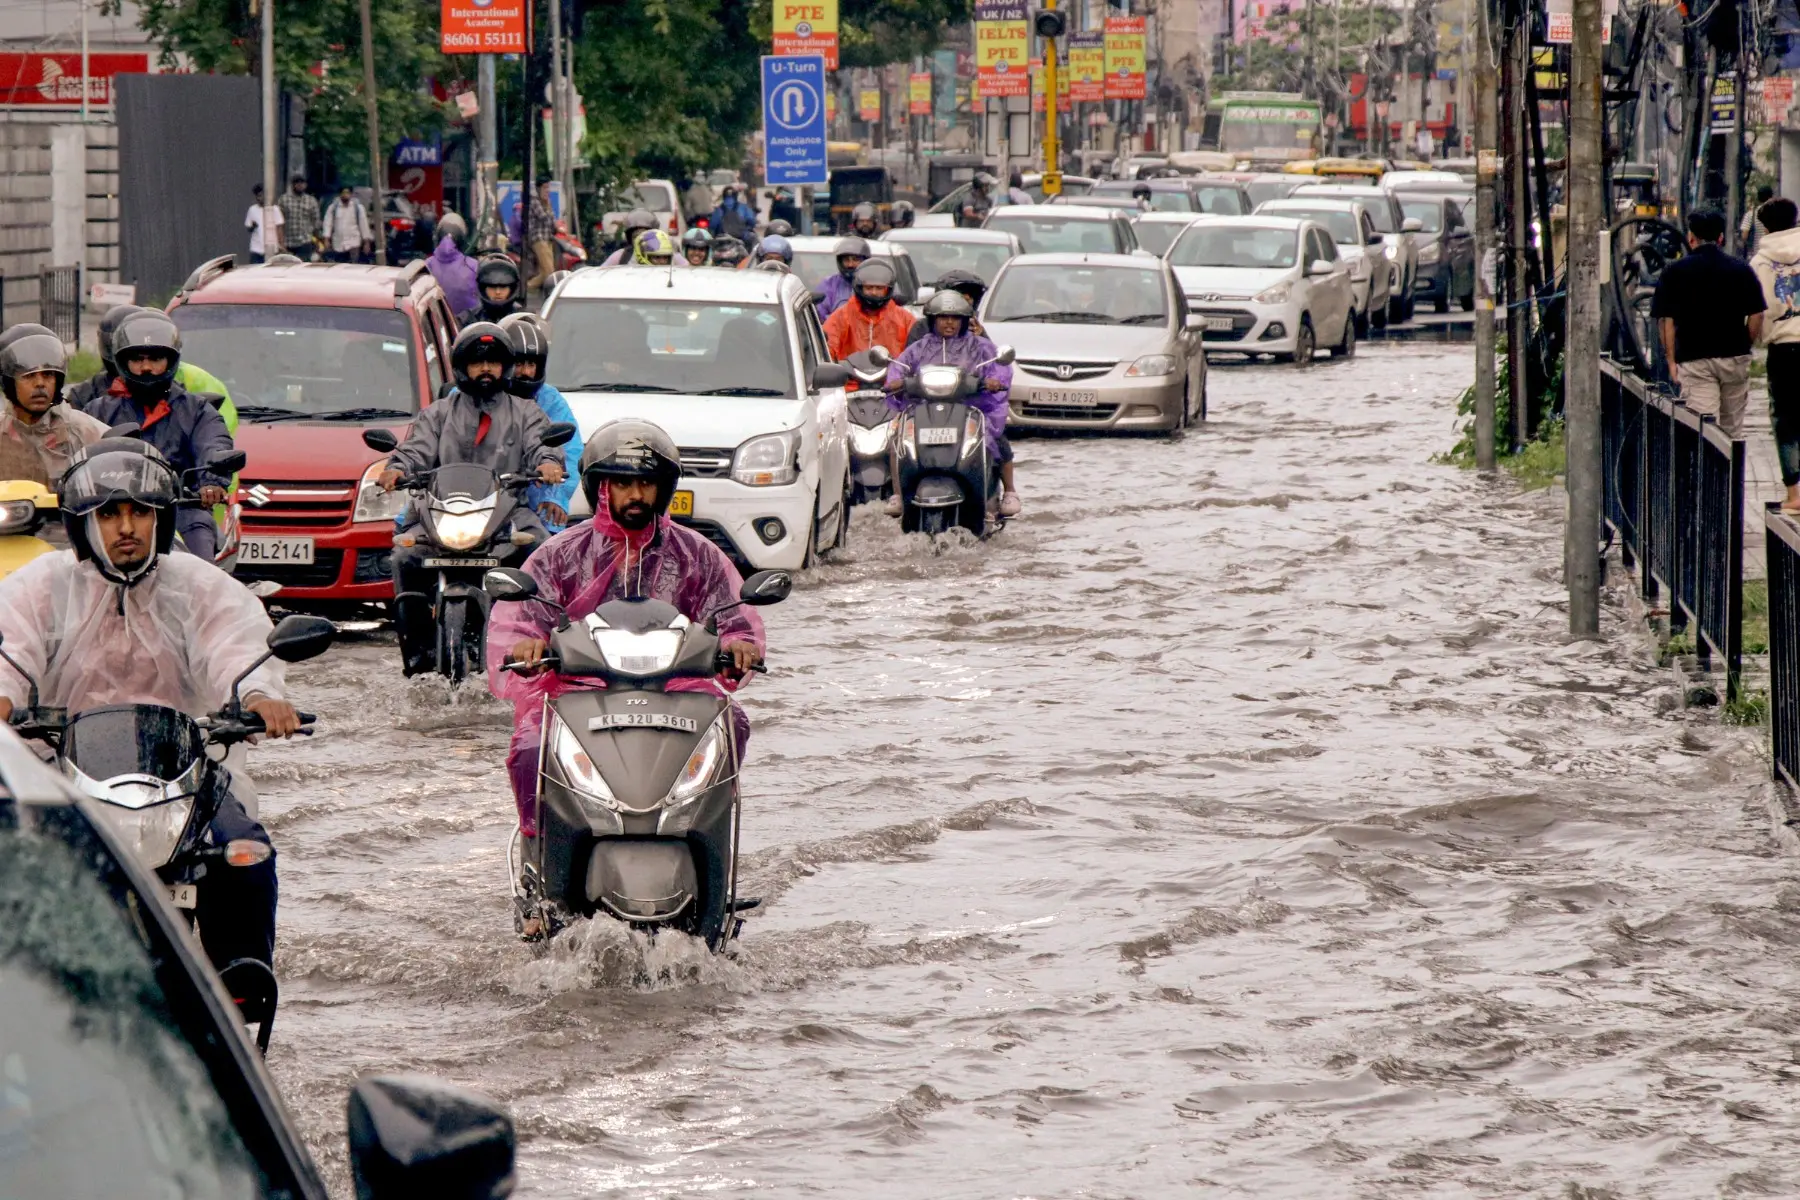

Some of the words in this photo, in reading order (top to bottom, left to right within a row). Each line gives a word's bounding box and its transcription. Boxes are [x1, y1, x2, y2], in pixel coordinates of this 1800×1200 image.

[451, 7, 519, 17] International
[784, 5, 824, 20] PTE
[983, 10, 999, 19] UK
[1007, 10, 1023, 18] NZ
[464, 19, 505, 28] Academy
[443, 33, 480, 46] 86061
[484, 32, 521, 45] 55111
[979, 28, 1026, 40] IELTS
[774, 38, 836, 46] International
[1107, 40, 1142, 49] IELTS
[987, 47, 1018, 59] PTE
[1112, 57, 1136, 66] PTE
[771, 61, 817, 74] U-Turn
[1077, 66, 1098, 74] PTE
[770, 136, 821, 145] Ambulance
[397, 147, 437, 164] ATM
[785, 147, 808, 157] Only
[1032, 392, 1043, 401] KL
[1062, 392, 1067, 400] A
[1071, 393, 1094, 403] 0232
[241, 543, 309, 559] 7BL2141
[602, 715, 618, 726] KL
[628, 714, 653, 724] 32U
[663, 715, 695, 729] 3601
